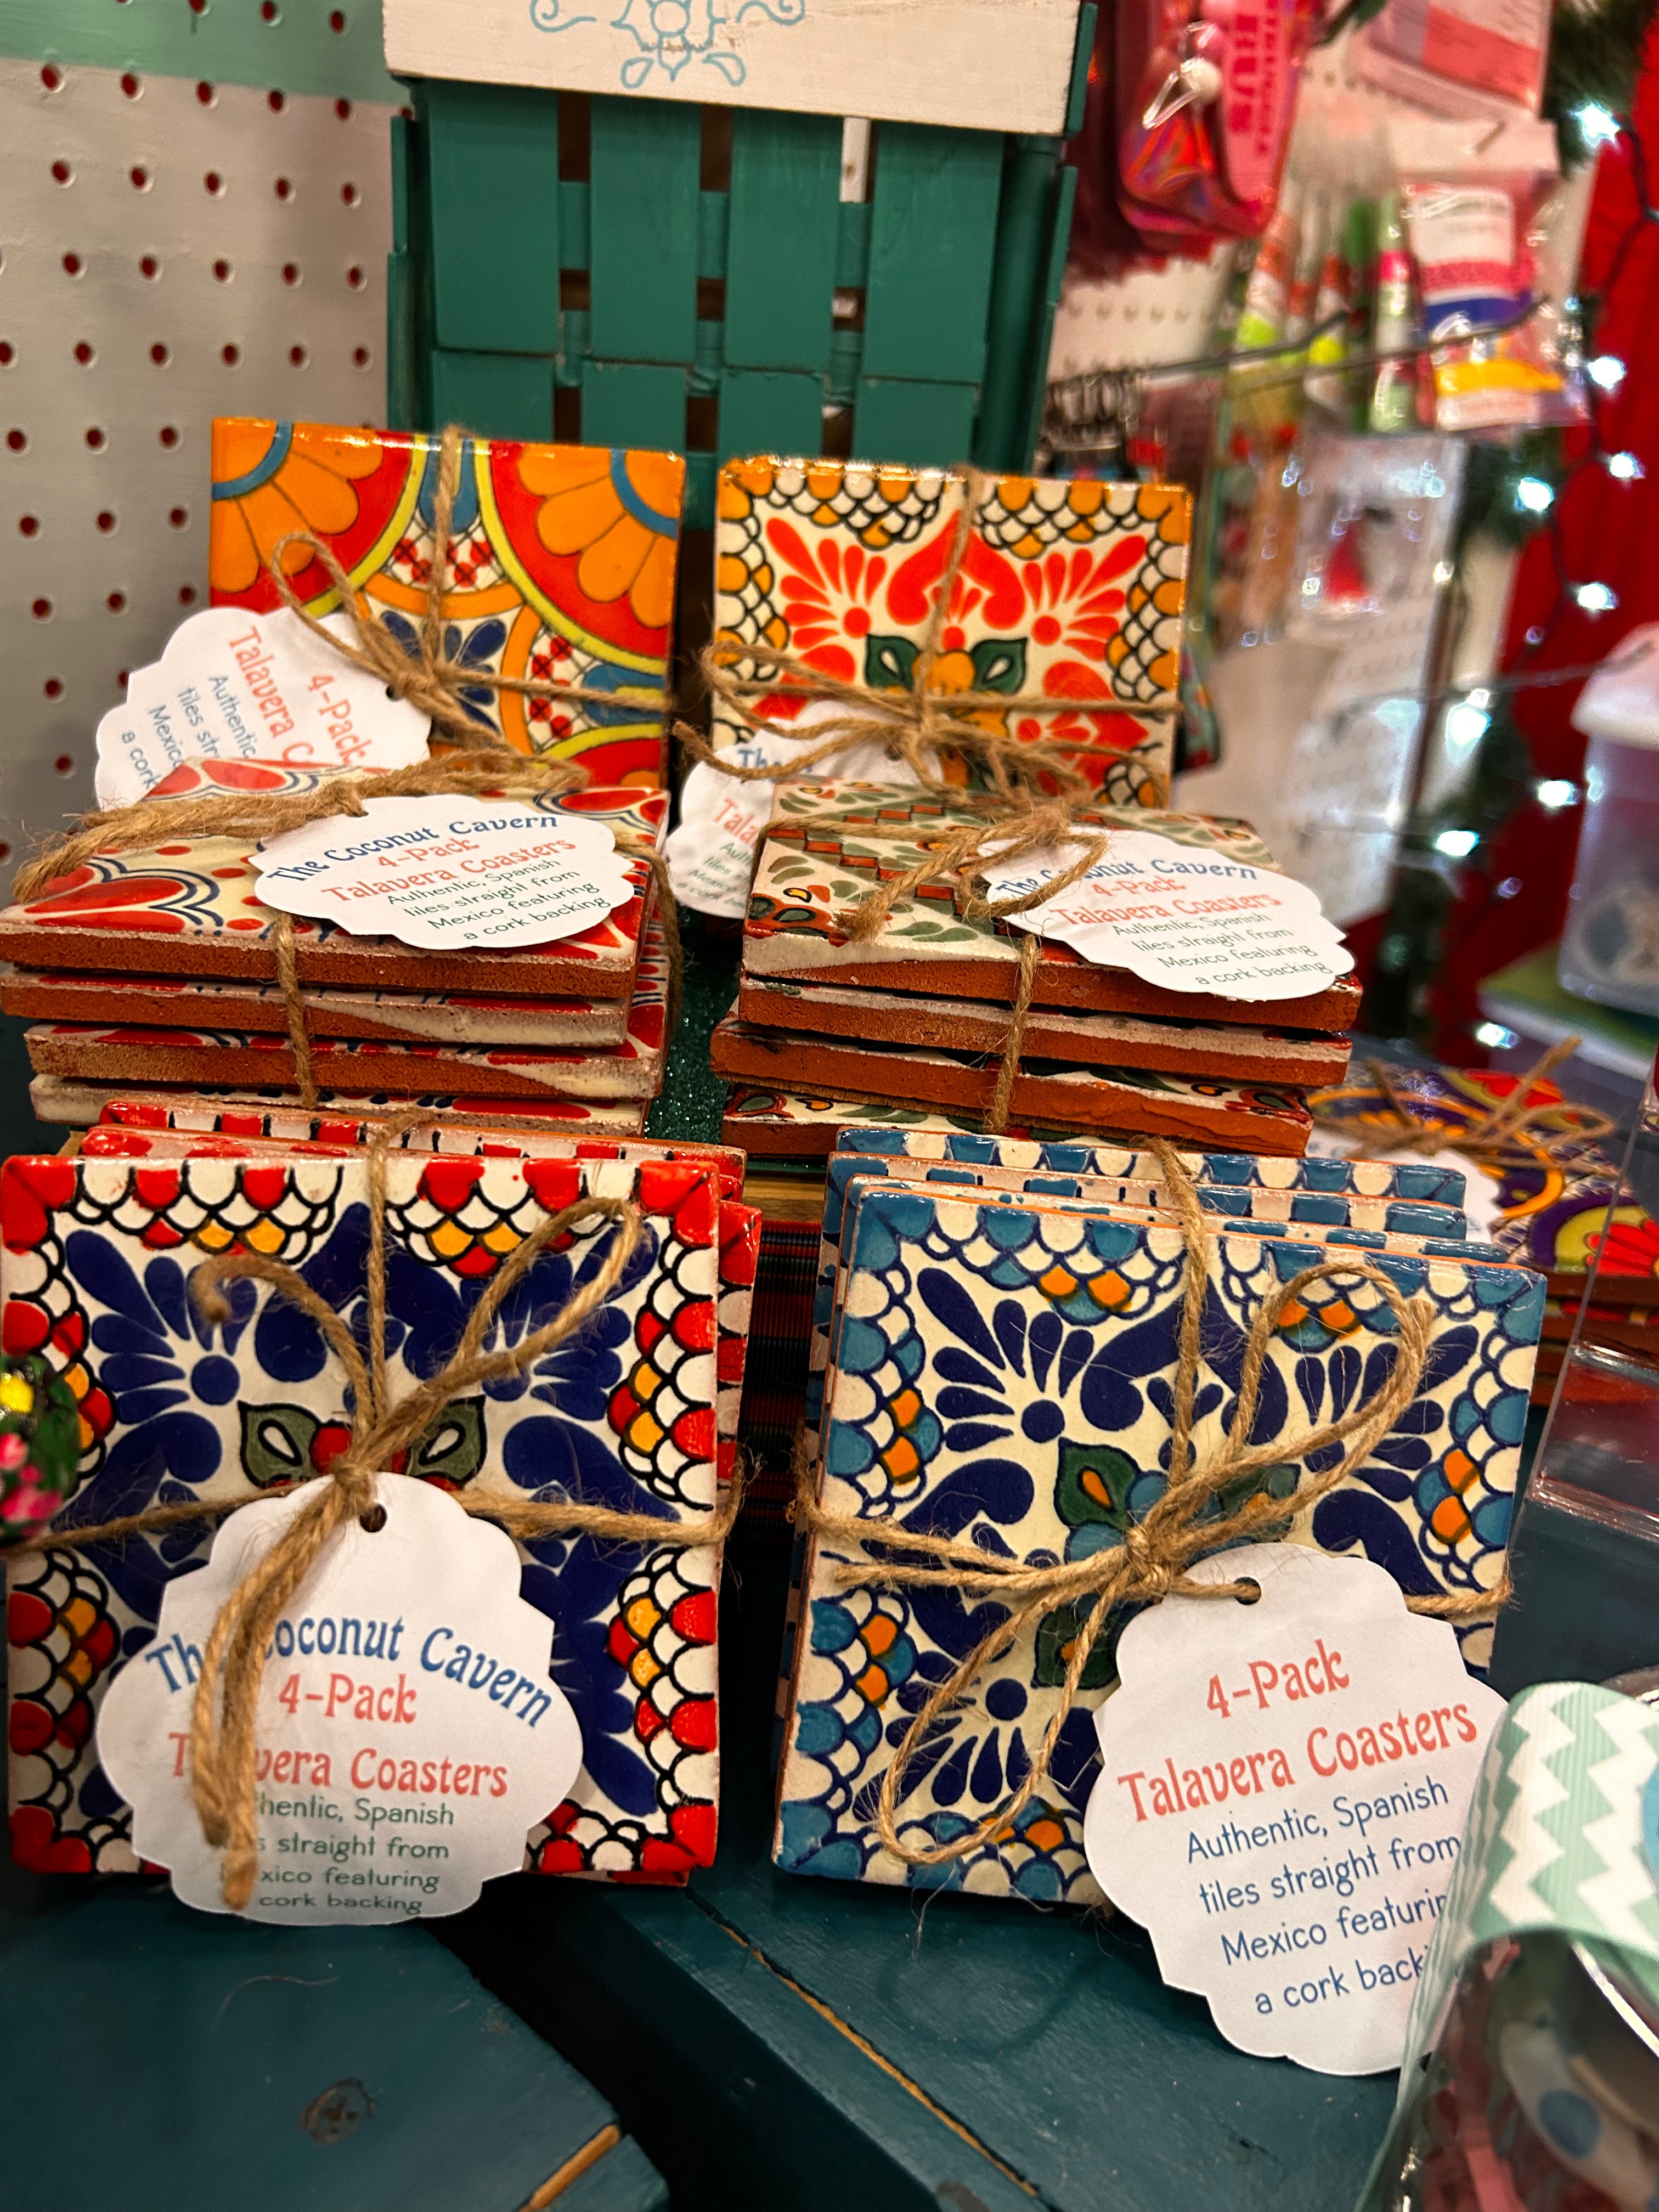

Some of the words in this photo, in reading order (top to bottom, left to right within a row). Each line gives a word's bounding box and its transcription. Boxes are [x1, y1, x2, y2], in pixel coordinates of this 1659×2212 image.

[229, 625, 295, 740] Talavera
[178, 686, 204, 727] tiles
[308, 675, 373, 765] 4-Pack
[122, 730, 136, 744] a
[129, 747, 162, 789] cork
[714, 798, 758, 849] Tala
[267, 862, 330, 881] The
[324, 827, 439, 861] Coconut
[449, 816, 557, 834] Cavern
[320, 869, 458, 901] Talavera
[460, 839, 577, 873] Coasters
[377, 838, 480, 867] 4-Pack
[1151, 859, 1257, 880] Cavern
[387, 880, 487, 905] Authentic,
[484, 859, 561, 882] Spanish
[404, 900, 450, 917] tiles
[455, 883, 529, 907] straight
[531, 871, 580, 887] from
[1092, 876, 1186, 896] 4-Pack
[427, 907, 504, 930] Mexico
[507, 882, 600, 910] featuring
[464, 931, 478, 940] a
[483, 917, 531, 935] cork
[528, 896, 611, 922] backing
[1050, 905, 1173, 925] Talavera
[1172, 894, 1282, 915] Coasters
[1112, 920, 1203, 936] Authentic,
[1199, 912, 1272, 930] Spanish
[1131, 939, 1175, 952] tiles
[1178, 932, 1246, 947] straight
[1246, 927, 1294, 940] from
[1157, 953, 1228, 968] Mexico
[1229, 944, 1318, 960] featuring
[1195, 975, 1210, 985] a
[1213, 968, 1256, 983] cork
[1254, 961, 1334, 977] backing
[145, 1633, 219, 1693] Th
[266, 1616, 405, 1661] oconut
[420, 1627, 552, 1728] Cavern
[1206, 1639, 1350, 1718] 4-Pack
[279, 1673, 417, 1723] 4-Pack
[168, 1732, 332, 1787] Tvera
[350, 1748, 508, 1797] Coasters
[1118, 1747, 1295, 1822] Talavera
[1307, 1703, 1478, 1778] Coasters
[258, 1791, 343, 1822] hentic,
[354, 1797, 454, 1831] Spanish
[1187, 1809, 1328, 1864] Authentic,
[1333, 1775, 1449, 1837] Spanish
[278, 1831, 375, 1863] straight
[387, 1836, 450, 1858] from
[230, 1864, 313, 1883] xico
[325, 1866, 441, 1893] featuring
[1199, 1881, 1260, 1915] tiles
[1271, 1844, 1379, 1897] straight
[1388, 1836, 1460, 1870] from
[259, 1893, 317, 1908] cork
[328, 1893, 422, 1915] backing
[1221, 1922, 1327, 1966] Mexico
[1336, 1888, 1447, 1938] featurin
[1255, 1991, 1273, 2015] a
[1284, 1965, 1350, 2008] cork
[1355, 1945, 1429, 1990] back
